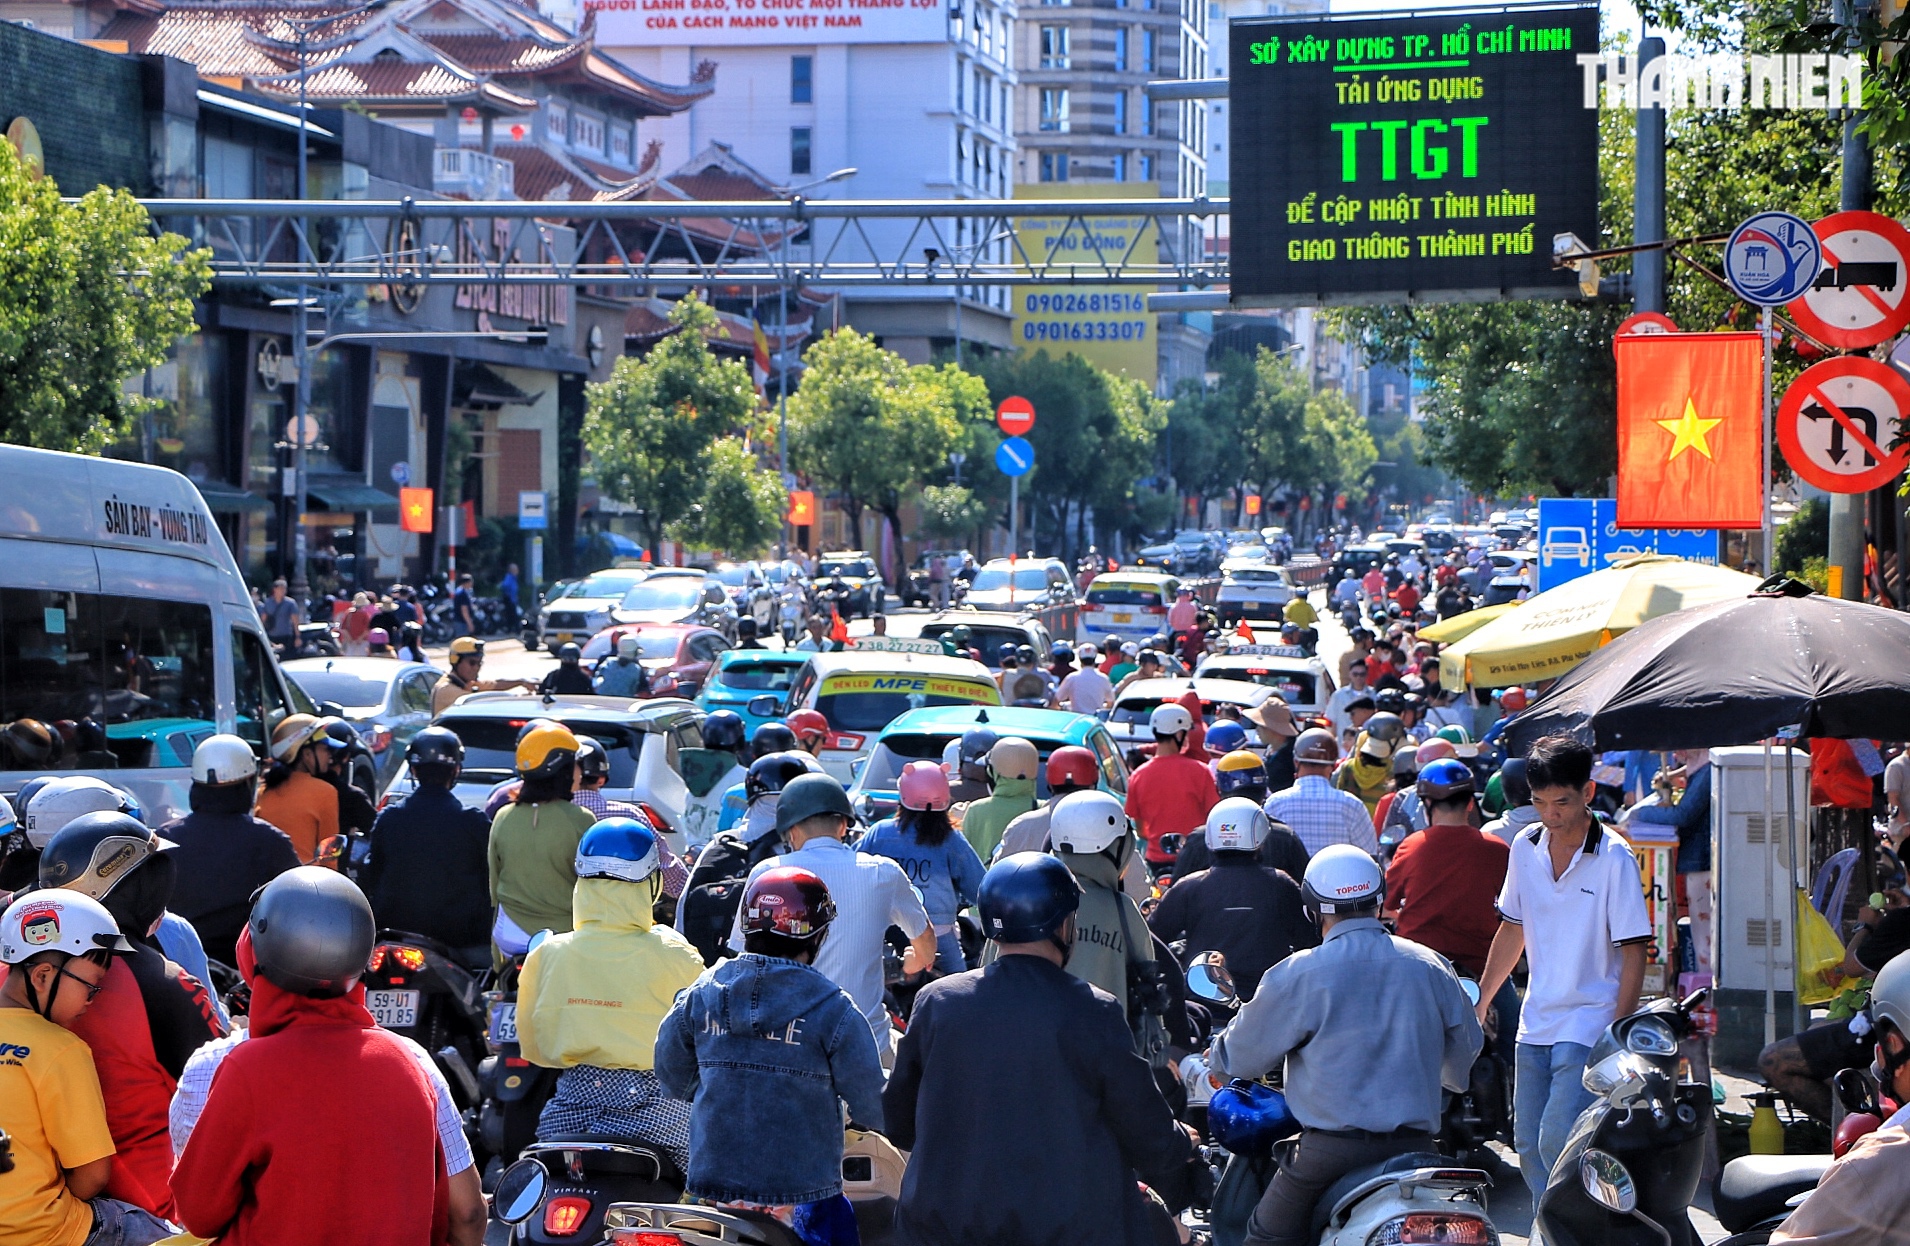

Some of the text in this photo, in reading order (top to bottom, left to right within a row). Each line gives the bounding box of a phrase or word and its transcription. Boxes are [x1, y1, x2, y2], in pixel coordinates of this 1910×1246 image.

[824, 15, 862, 28] NAM
[1250, 36, 1281, 65] SỞ
[1288, 34, 1330, 63] XÂY
[1336, 36, 1394, 64] DỰNG
[1402, 34, 1435, 58] TP.
[1476, 24, 1514, 54] CHÍ
[1519, 28, 1572, 53] MINH
[1334, 74, 1484, 105] TẢI ỨNG DỤNG
[1330, 116, 1489, 183] TTGT
[1321, 195, 1362, 226] CẬP
[1369, 192, 1423, 225] NHẬT
[1288, 239, 1336, 261] GIAO
[1342, 232, 1410, 260] THÔNG
[1491, 222, 1535, 255] PHỐ
[1026, 293, 1144, 313] 0902681516
[1024, 321, 1146, 341] 0901633307
[104, 493, 130, 536] SÂN
[130, 503, 152, 538] BAY
[159, 502, 188, 543] VŨNG
[188, 505, 208, 545] TÀU
[853, 679, 870, 688] LED
[873, 678, 928, 691] MPE
[1336, 882, 1370, 895] TOPCOM
[1077, 924, 1123, 953] nball
[374, 993, 410, 1008] 59-U1
[567, 997, 623, 1008] RHYME ORANGE
[501, 1023, 516, 1040] 59
[0, 1042, 31, 1058] re
